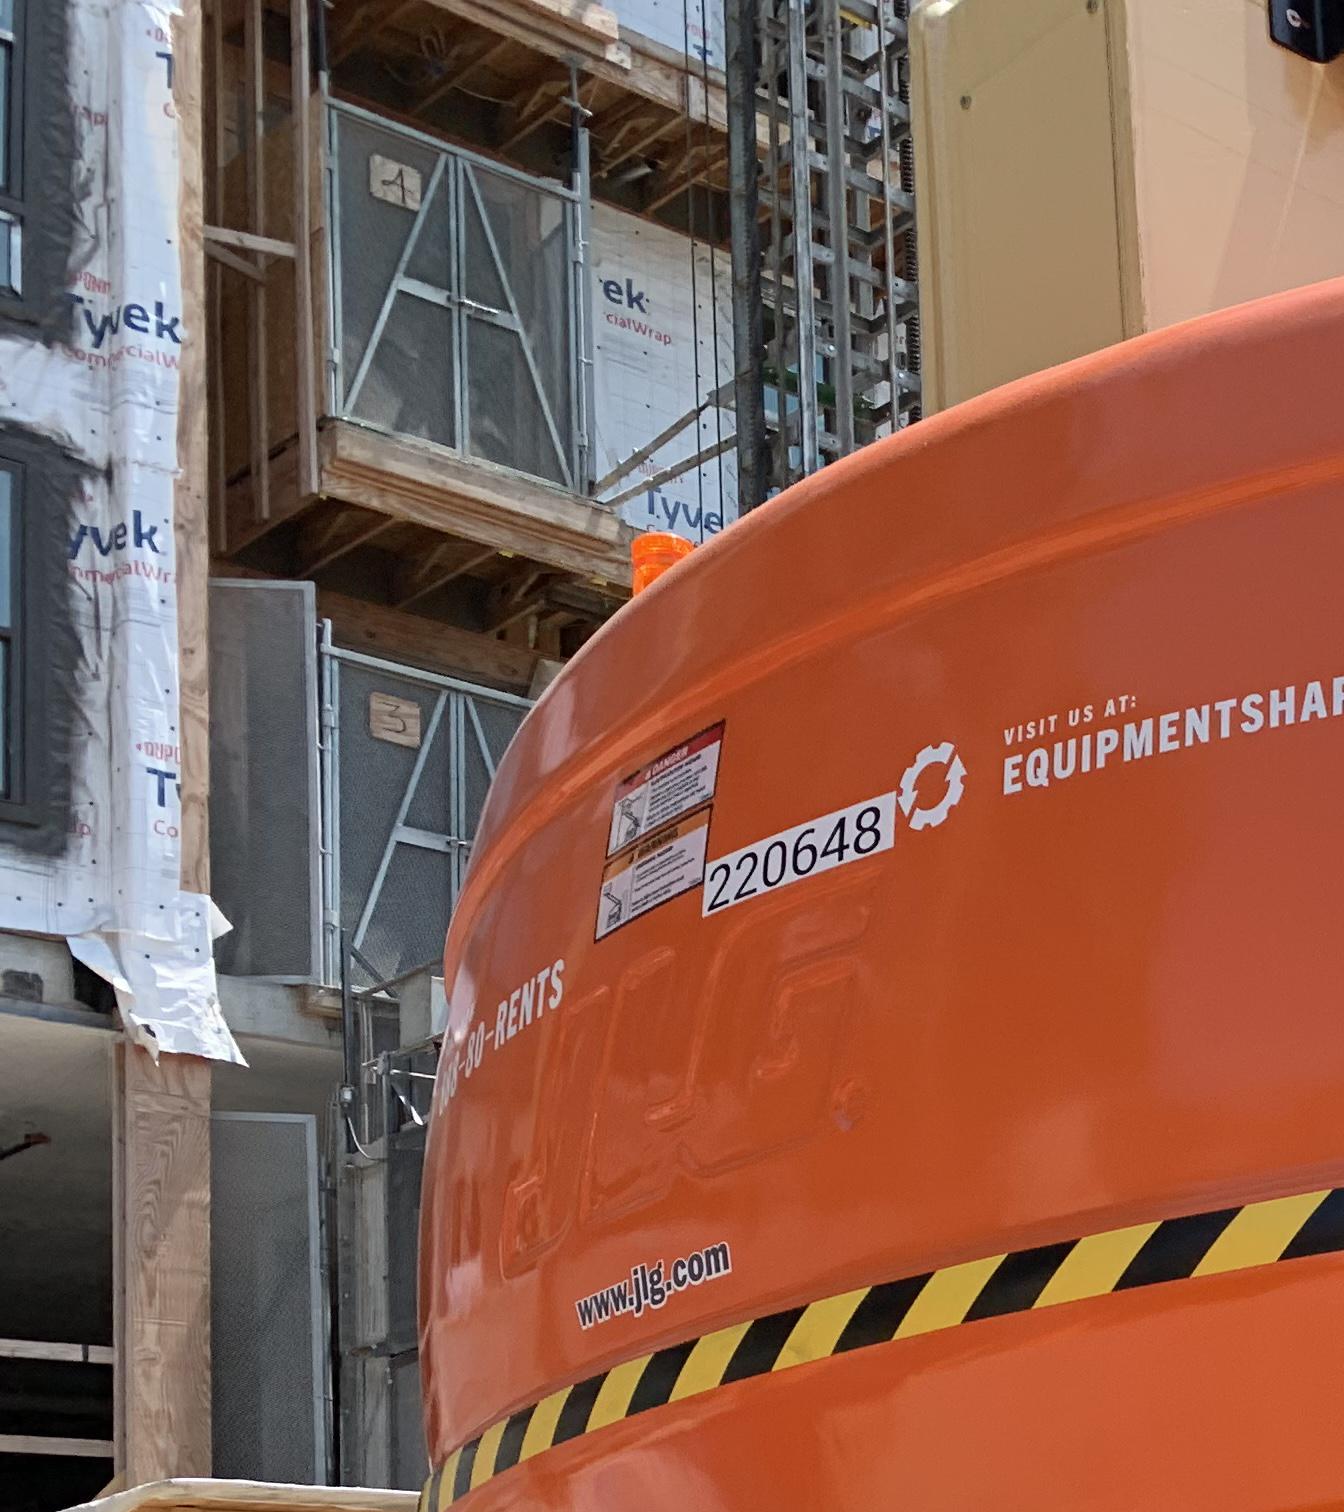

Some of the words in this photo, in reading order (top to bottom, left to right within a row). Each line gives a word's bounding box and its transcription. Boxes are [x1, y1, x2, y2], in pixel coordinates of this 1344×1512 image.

[379, 701, 407, 734] 3
[1003, 714, 1058, 746] VISIT
[1068, 703, 1094, 729] US
[1104, 694, 1137, 718] AT:
[707, 805, 882, 913] 220648
[576, 1242, 731, 1329] www.jlg.com
